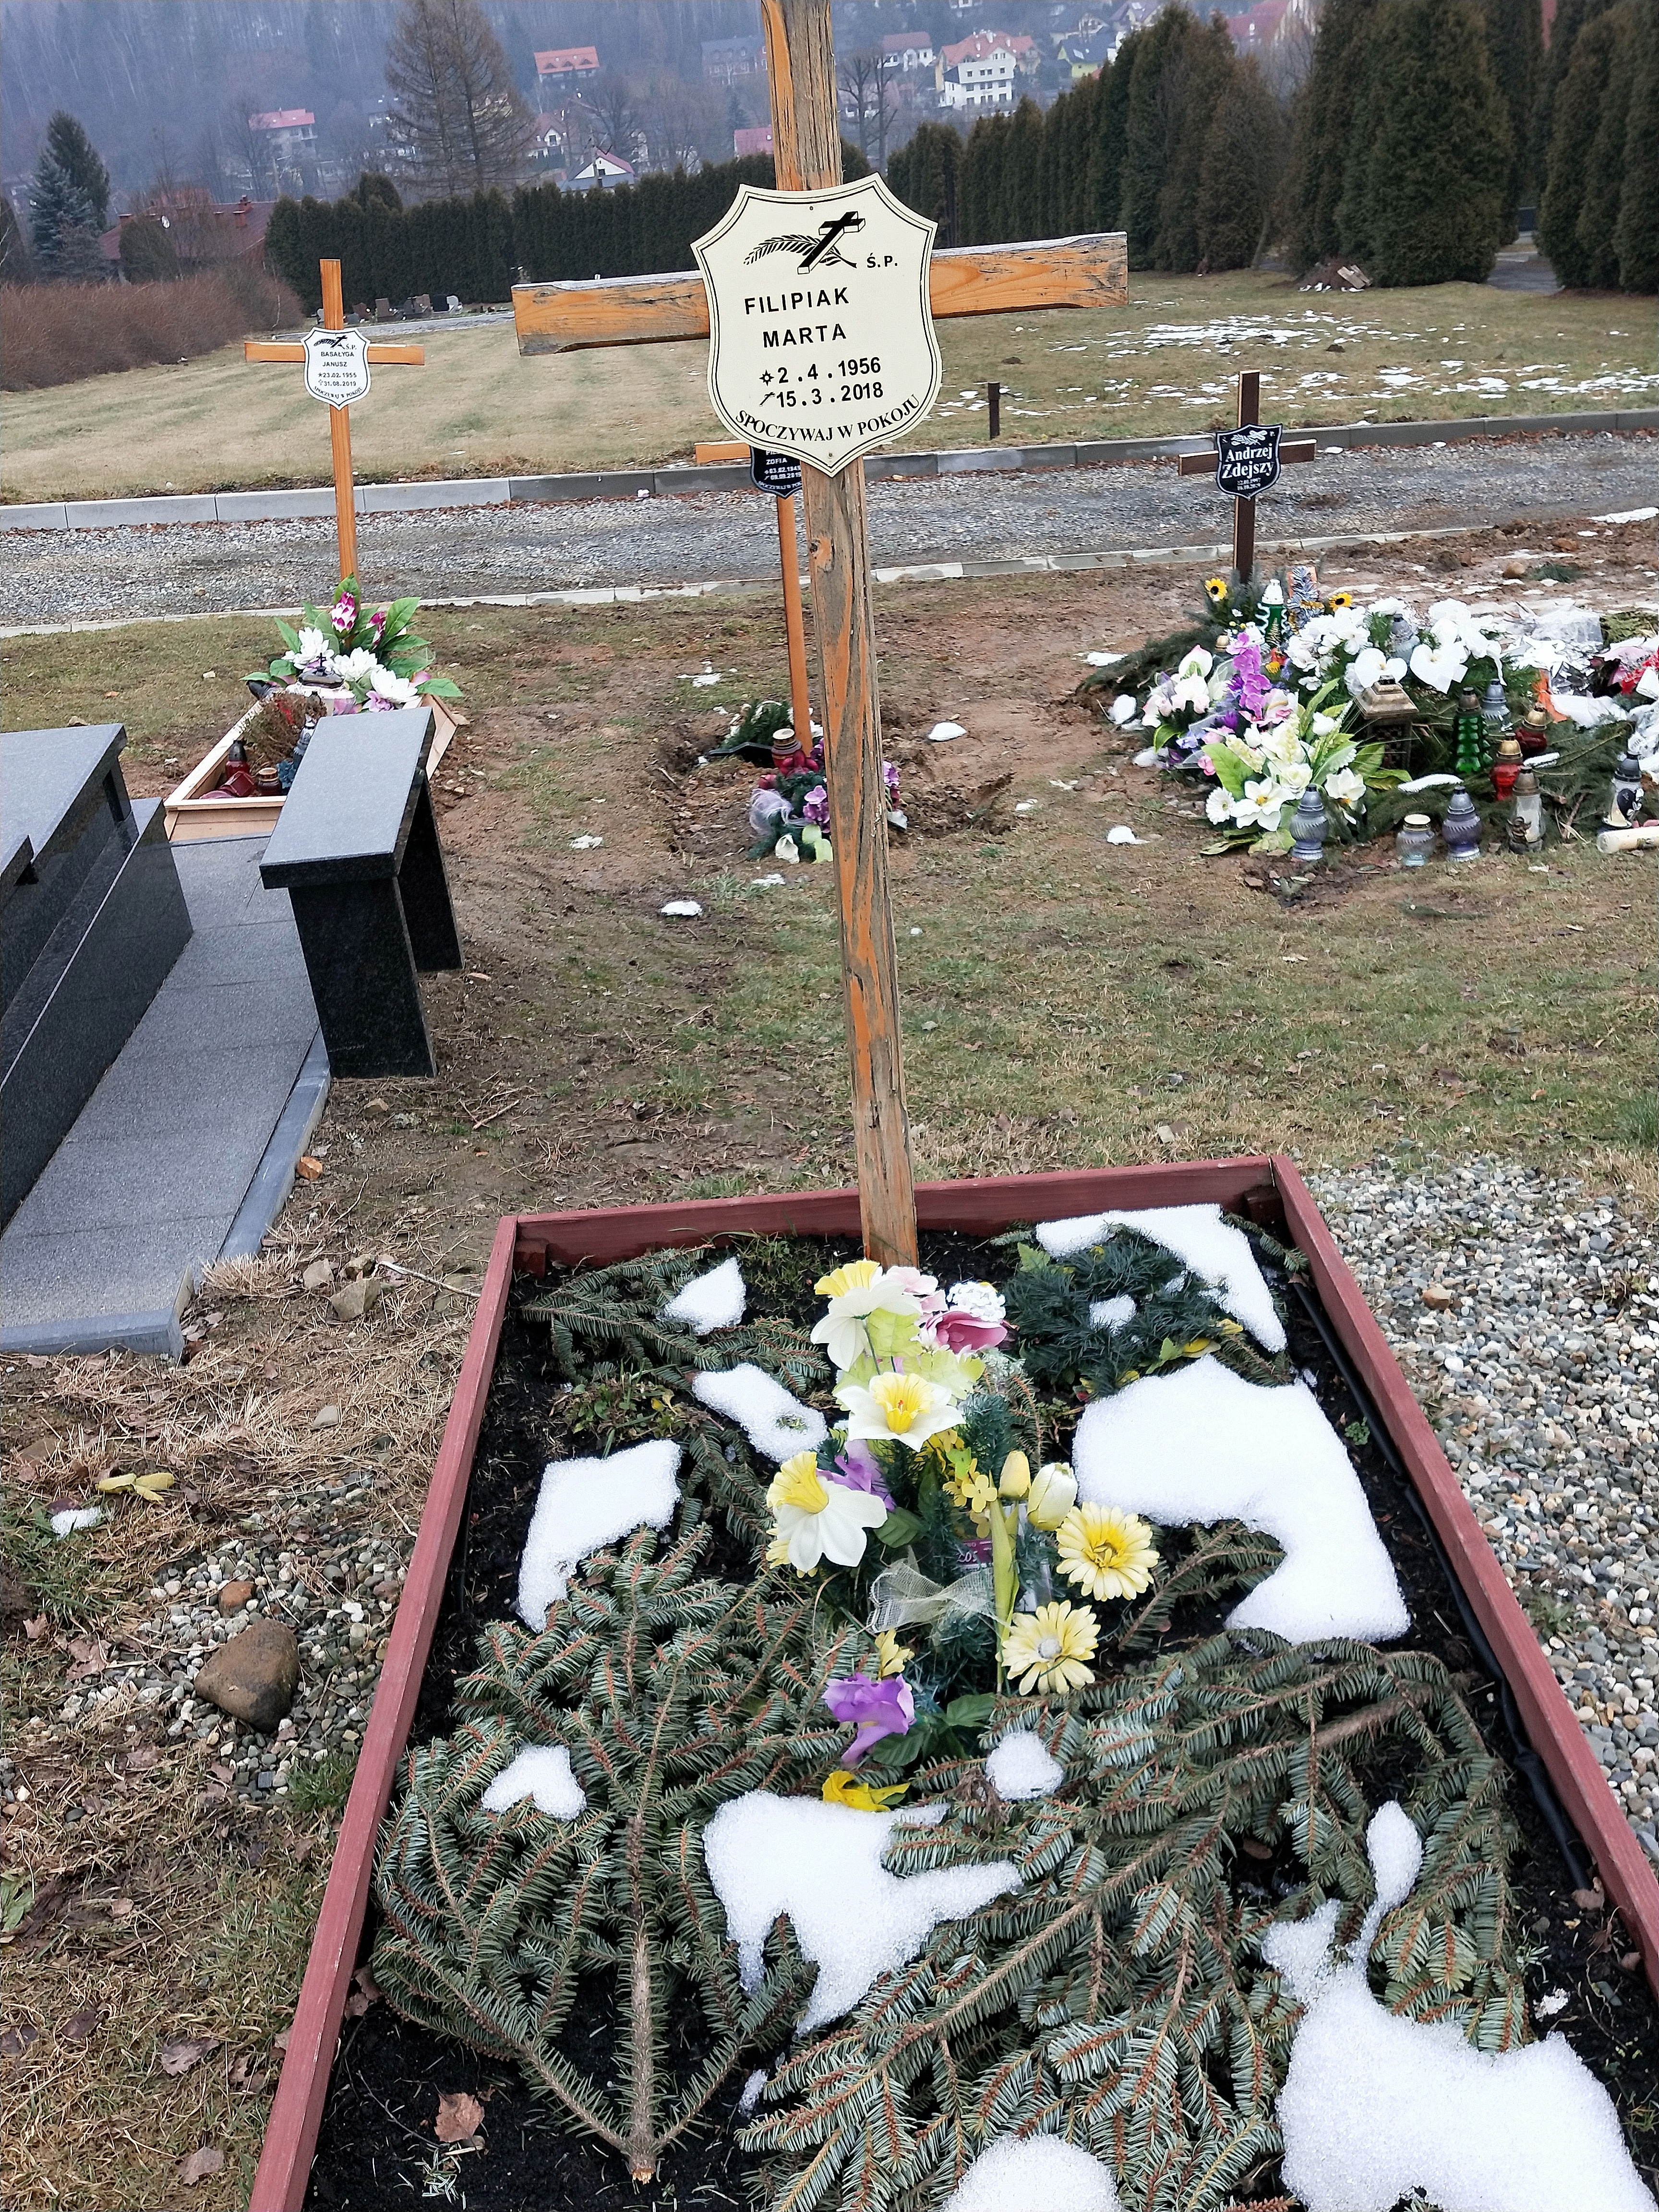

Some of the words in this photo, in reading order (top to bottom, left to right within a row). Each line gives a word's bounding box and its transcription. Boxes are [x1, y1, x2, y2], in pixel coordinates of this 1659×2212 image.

[745, 287, 849, 314] FILIPIAK
[763, 324, 846, 348] MARTA
[735, 410, 833, 441] SPOCZYWAJ
[838, 424, 854, 438] W
[857, 394, 920, 435] POKOJU
[1225, 443, 1273, 462] Andrzej
[1222, 461, 1274, 479] Zdejszy
